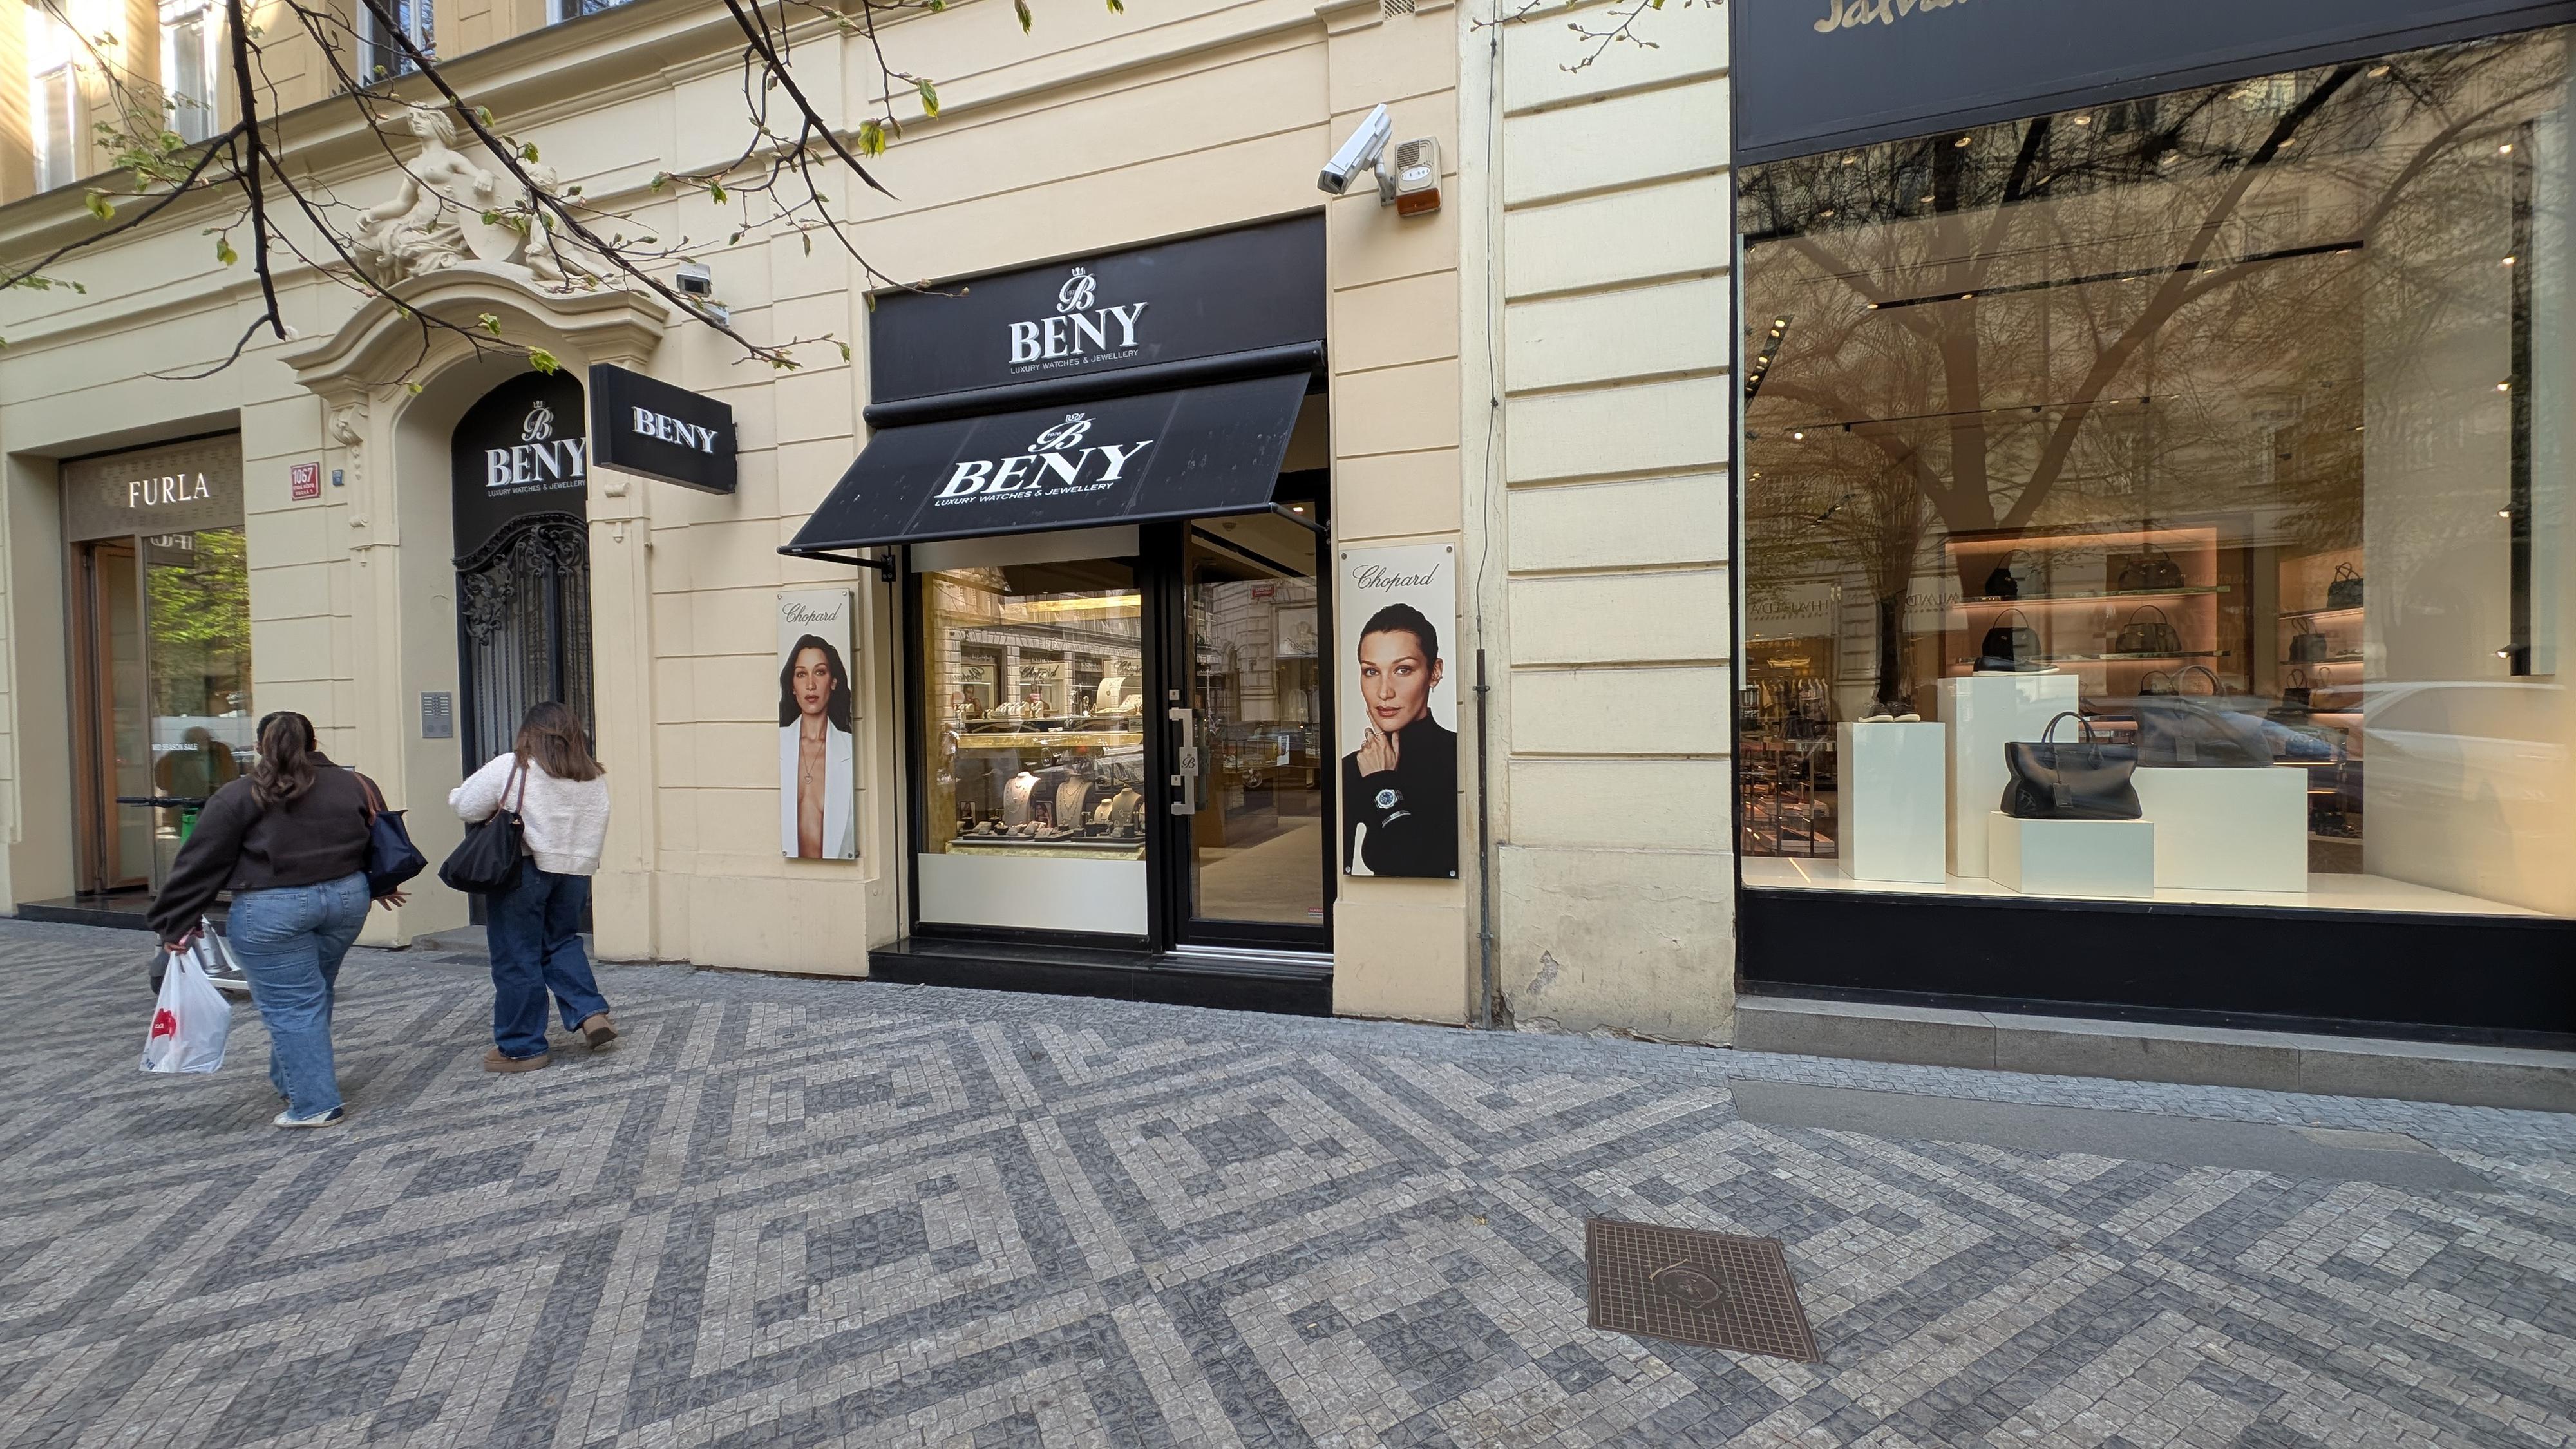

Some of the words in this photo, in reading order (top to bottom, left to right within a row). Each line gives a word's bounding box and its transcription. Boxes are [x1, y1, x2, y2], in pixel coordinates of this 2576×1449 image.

[1008, 302, 1149, 364] BENY
[1010, 365, 1040, 374] LUXURY
[1043, 358, 1080, 369] WATCHES
[1091, 350, 1139, 363] JEWELLERY
[631, 406, 719, 453] BENY
[293, 468, 313, 484] 1067
[484, 437, 587, 487] BENY
[934, 440, 1153, 498] BENY
[129, 471, 209, 508] FURLA
[512, 484, 541, 493] WATCHES
[549, 480, 586, 489] JEWELLERY
[934, 497, 976, 506] LUXURY
[980, 491, 1032, 502] WATCHES
[1045, 482, 1114, 496] JEWELLERY
[1352, 563, 1440, 592] Chopard
[782, 603, 842, 627] Chopard
